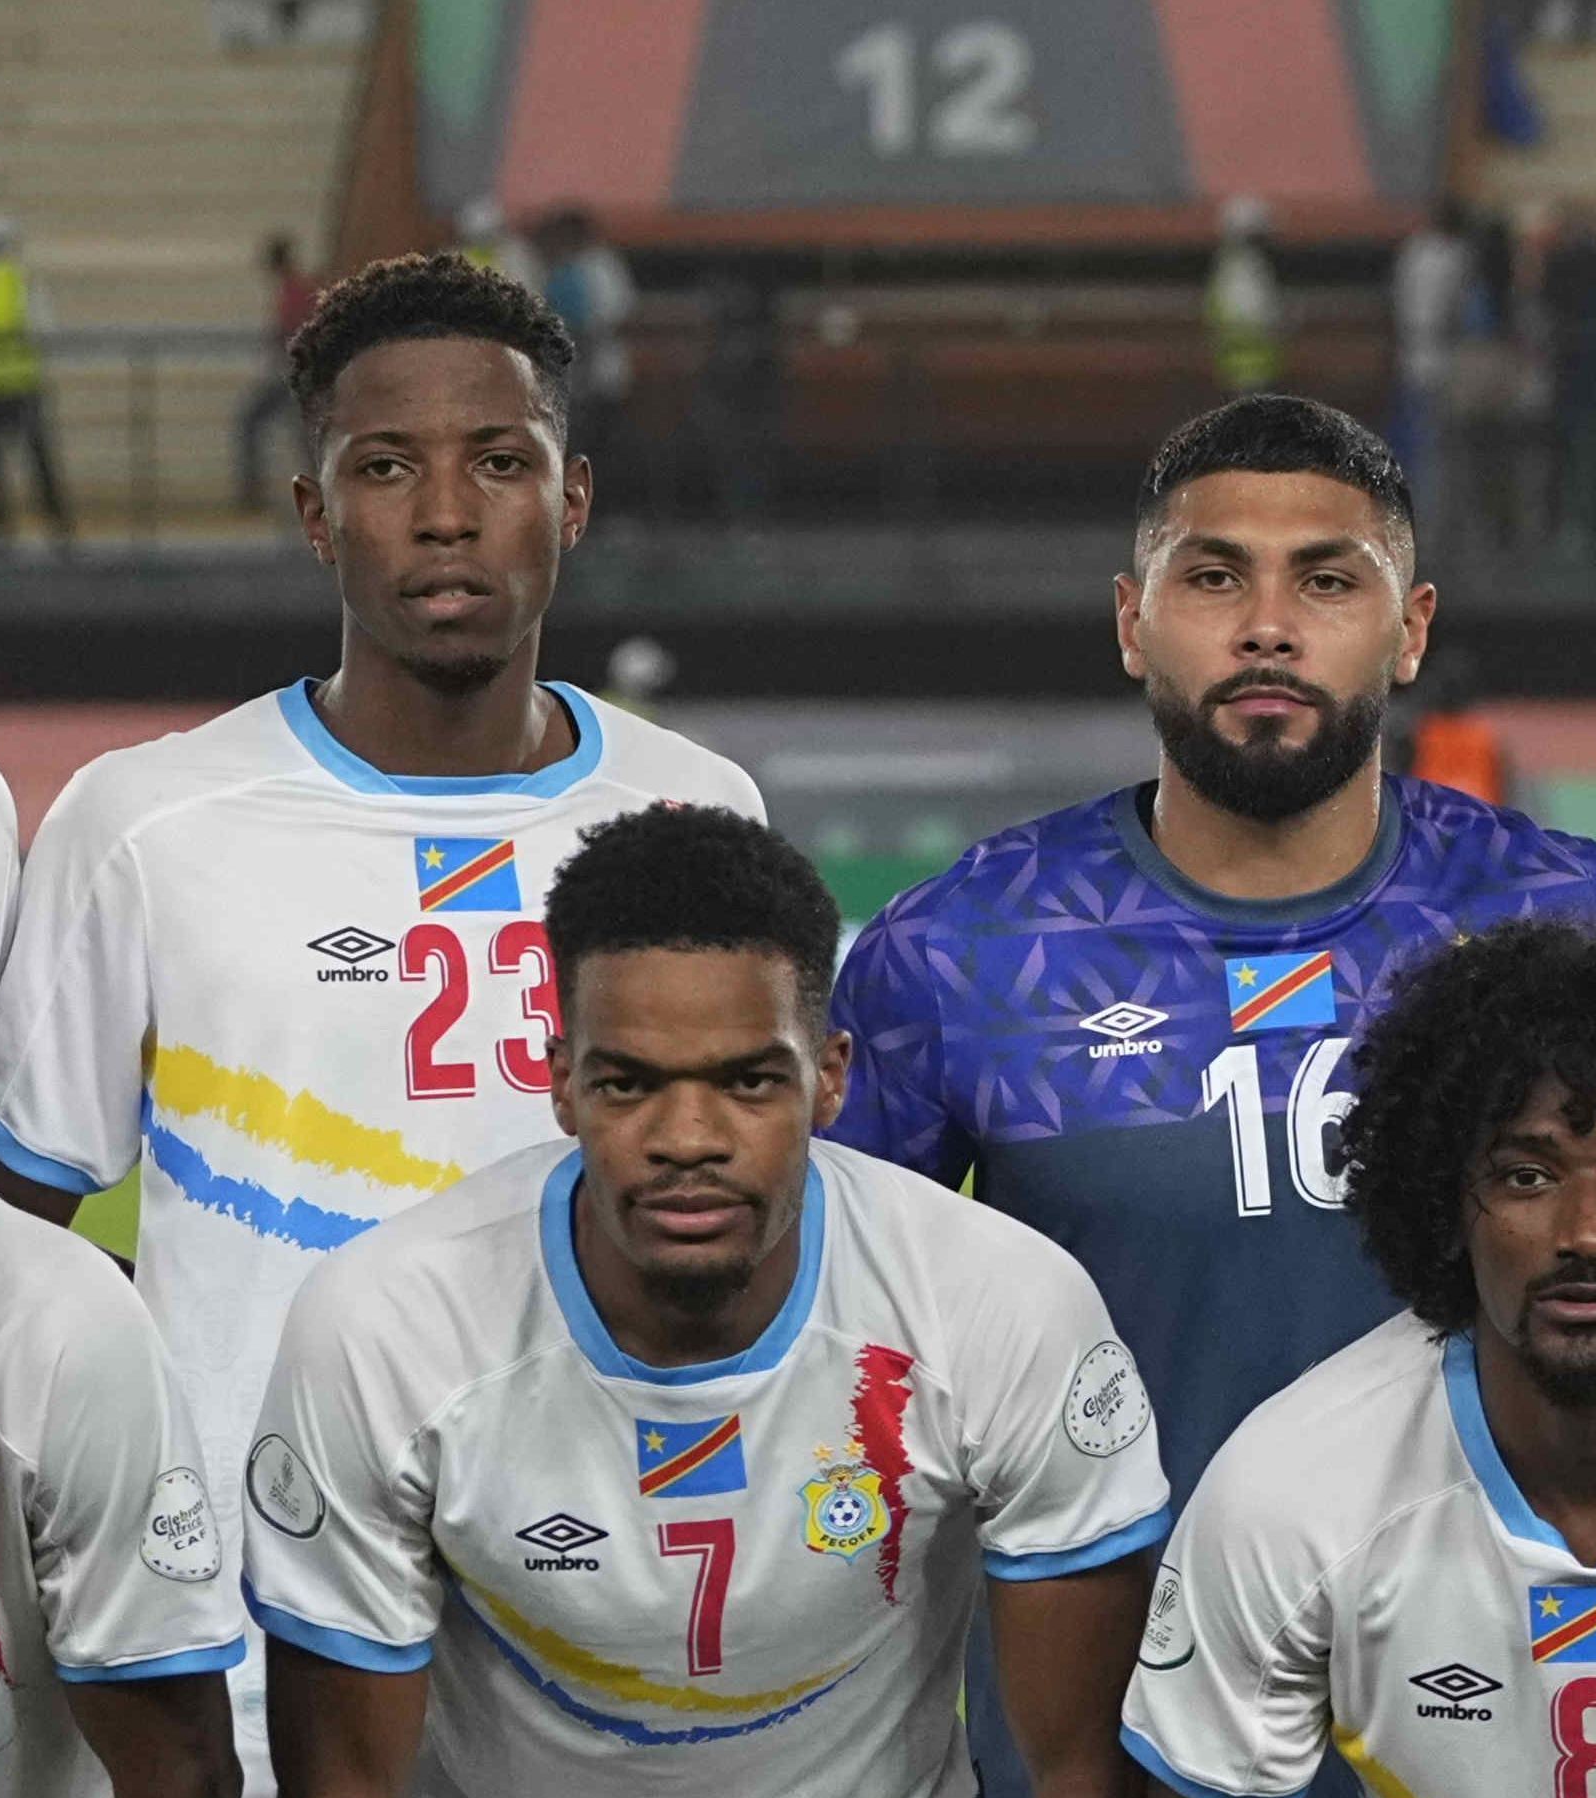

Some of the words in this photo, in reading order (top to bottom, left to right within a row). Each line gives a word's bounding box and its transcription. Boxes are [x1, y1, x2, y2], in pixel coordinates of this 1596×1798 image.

[834, 22, 1038, 160] 12
[317, 965, 388, 982] umbro
[1089, 1036, 1162, 1059] umbro
[1203, 1037, 1360, 1218] 16
[820, 1527, 877, 1549] FECOFA
[525, 1555, 600, 1572] umbro
[658, 1519, 735, 1677] 7
[1417, 1704, 1493, 1722] umbro
